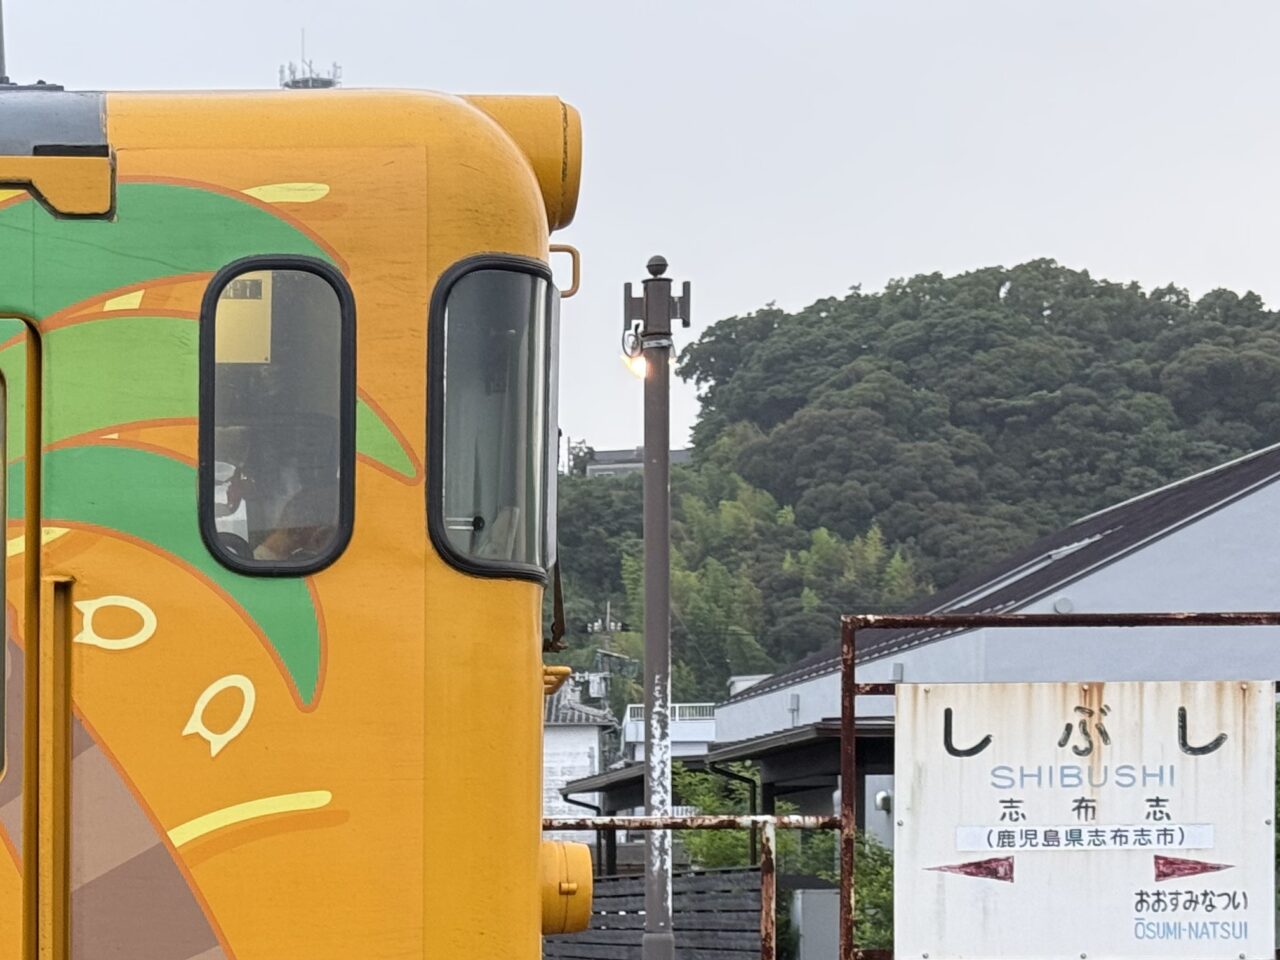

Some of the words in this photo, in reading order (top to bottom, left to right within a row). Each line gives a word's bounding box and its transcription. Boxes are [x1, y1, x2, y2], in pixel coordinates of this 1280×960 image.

[943, 704, 1228, 758] しぶし
[990, 764, 1175, 789] SHIBUSHI
[999, 796, 1172, 822] 志布志
[1134, 890, 1248, 913] おおすみなつい
